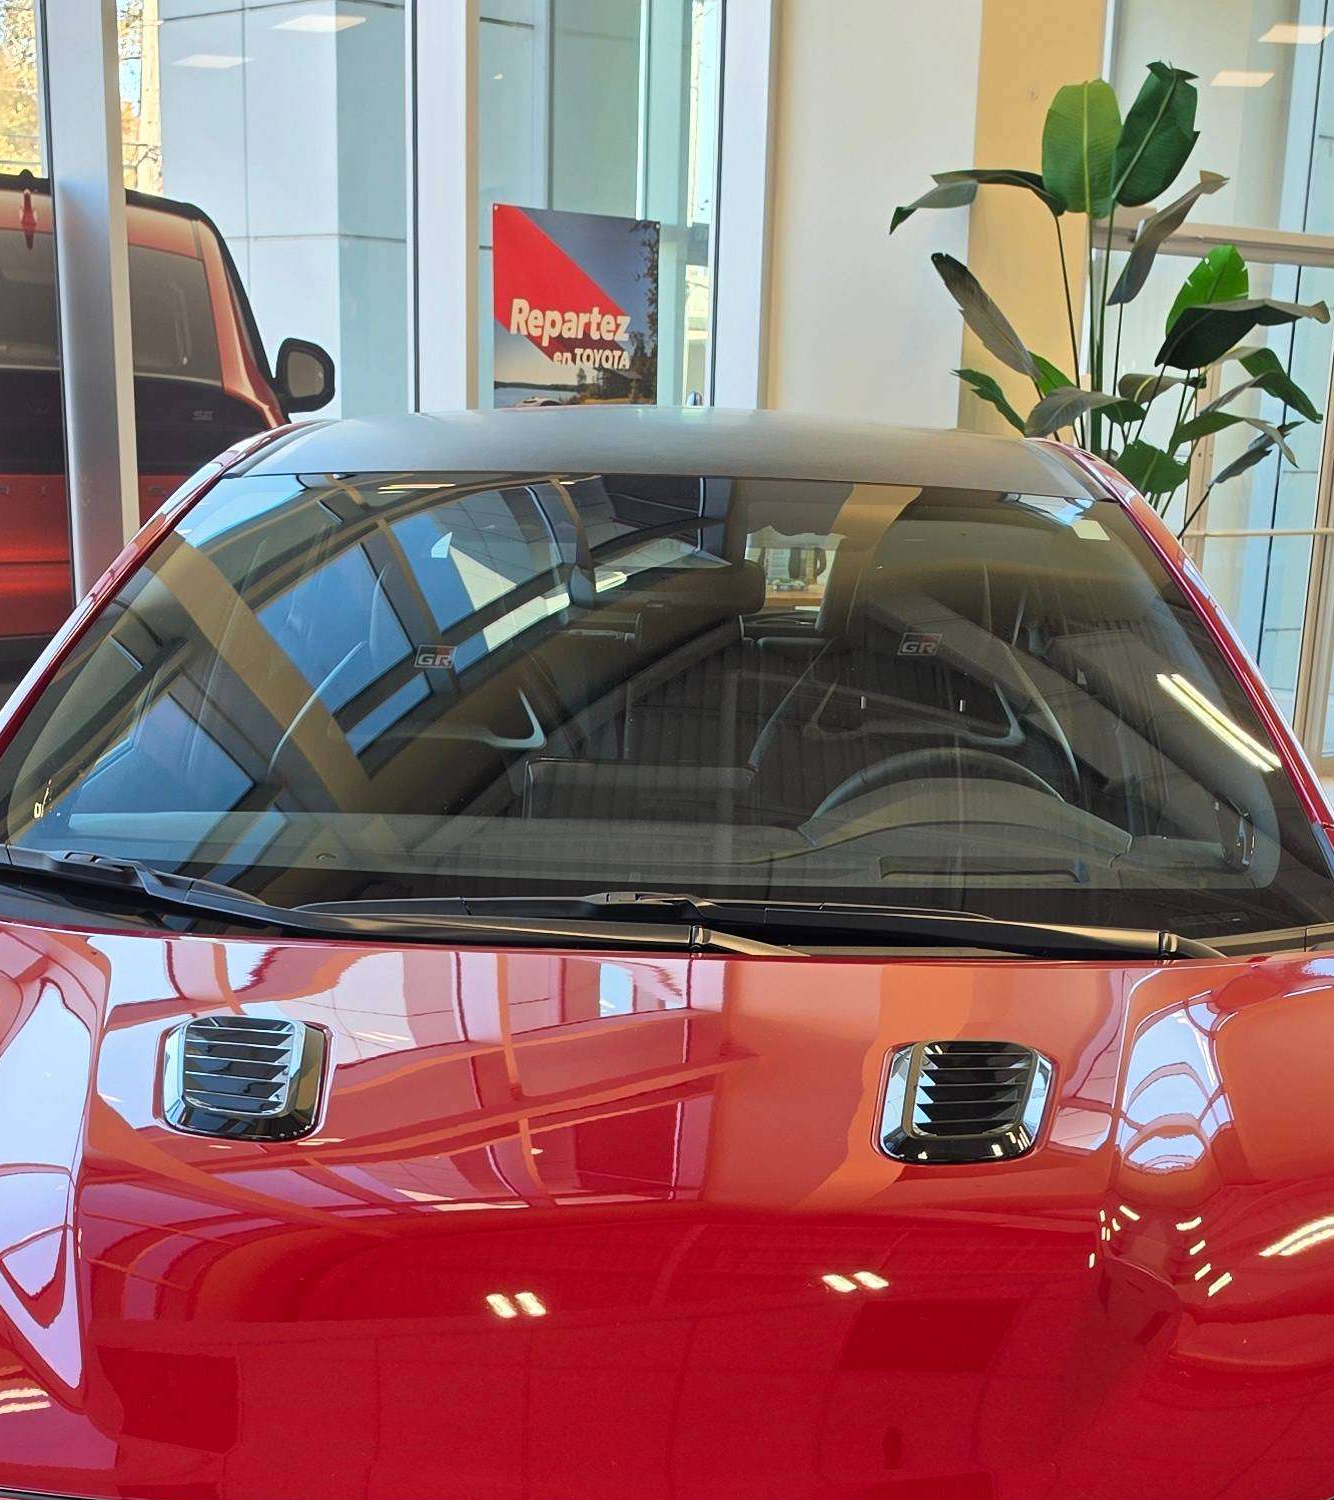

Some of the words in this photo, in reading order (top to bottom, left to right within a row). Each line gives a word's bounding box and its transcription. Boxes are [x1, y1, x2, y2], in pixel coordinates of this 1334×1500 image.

[510, 298, 631, 347] Repartez
[553, 351, 572, 365] en
[574, 348, 630, 369] TOYOTA
